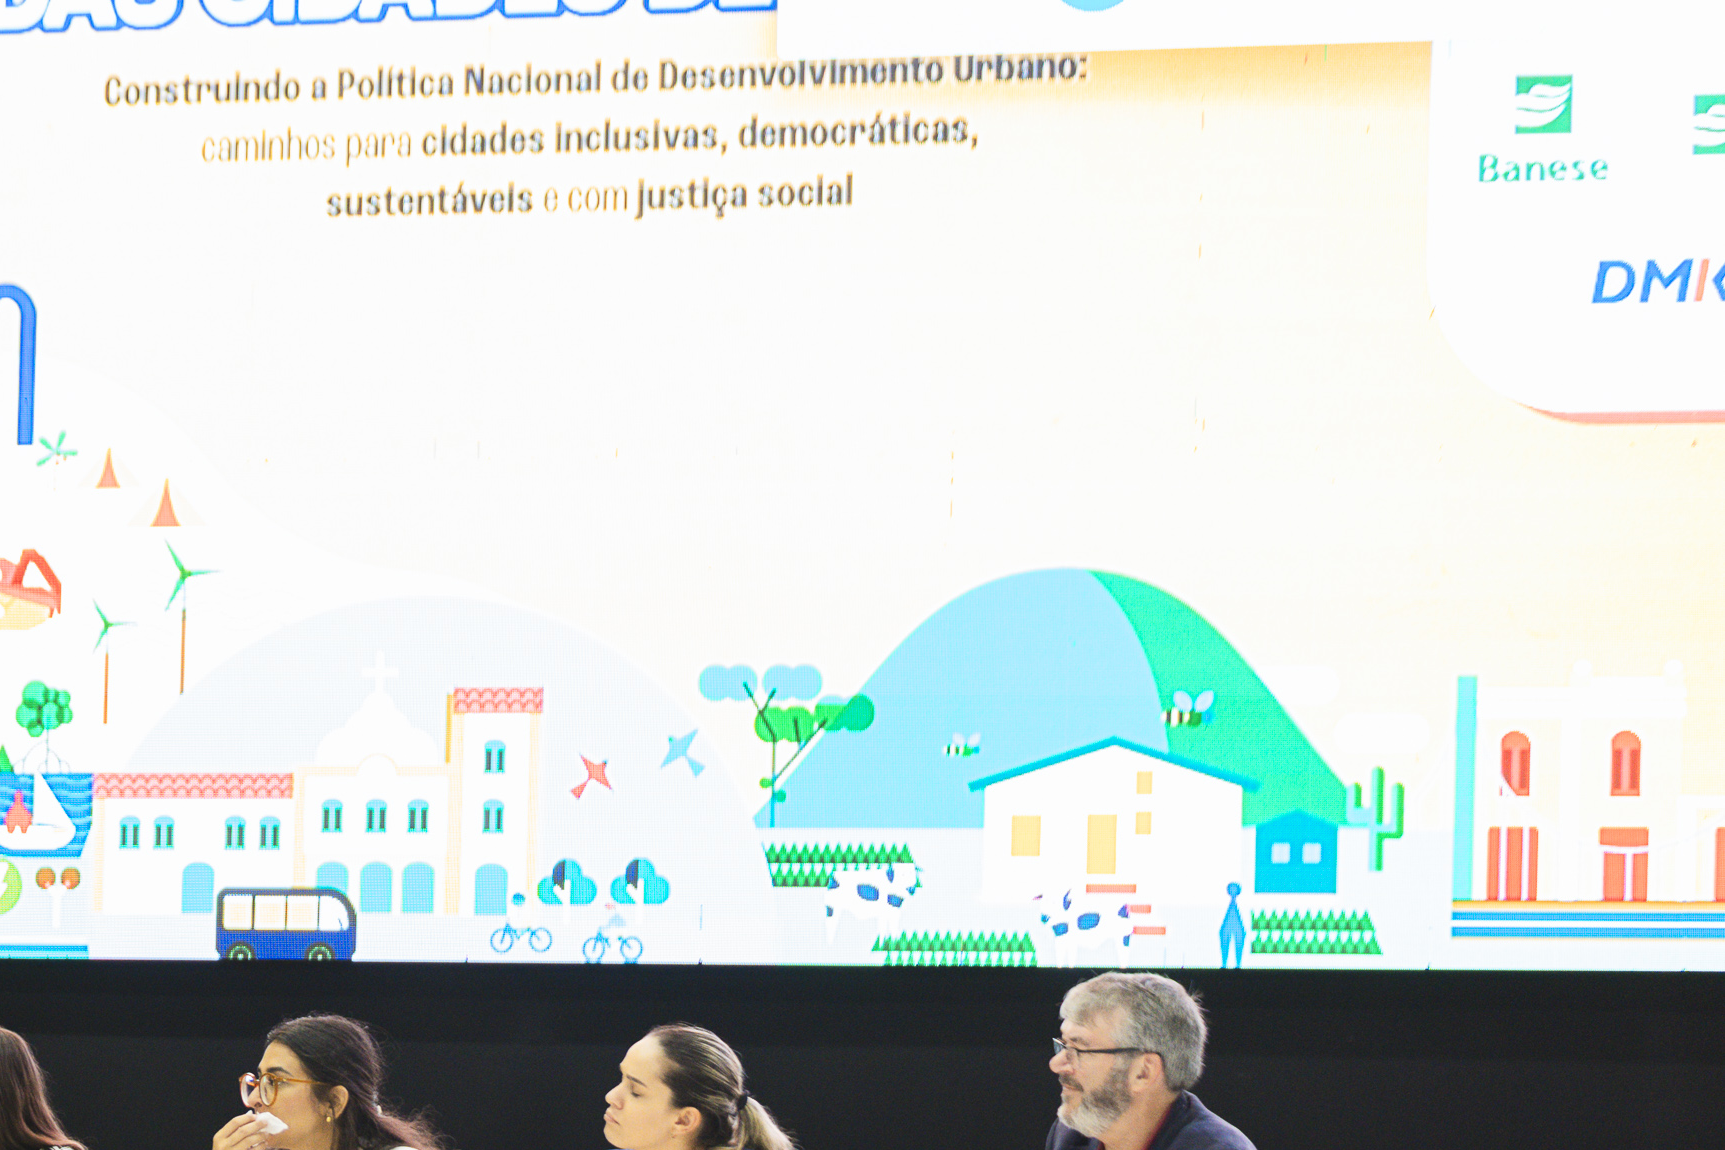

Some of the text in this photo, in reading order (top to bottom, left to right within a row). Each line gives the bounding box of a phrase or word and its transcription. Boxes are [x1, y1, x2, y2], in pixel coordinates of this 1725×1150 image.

[105, 54, 1088, 106] Construindo a Política Nacional de Desenvolvimento Urbano:
[202, 112, 979, 167] caminhos para cidades inclusivas, democráticas,
[1478, 154, 1609, 182] Banese
[327, 172, 853, 220] sustentáveis e com justiça social
